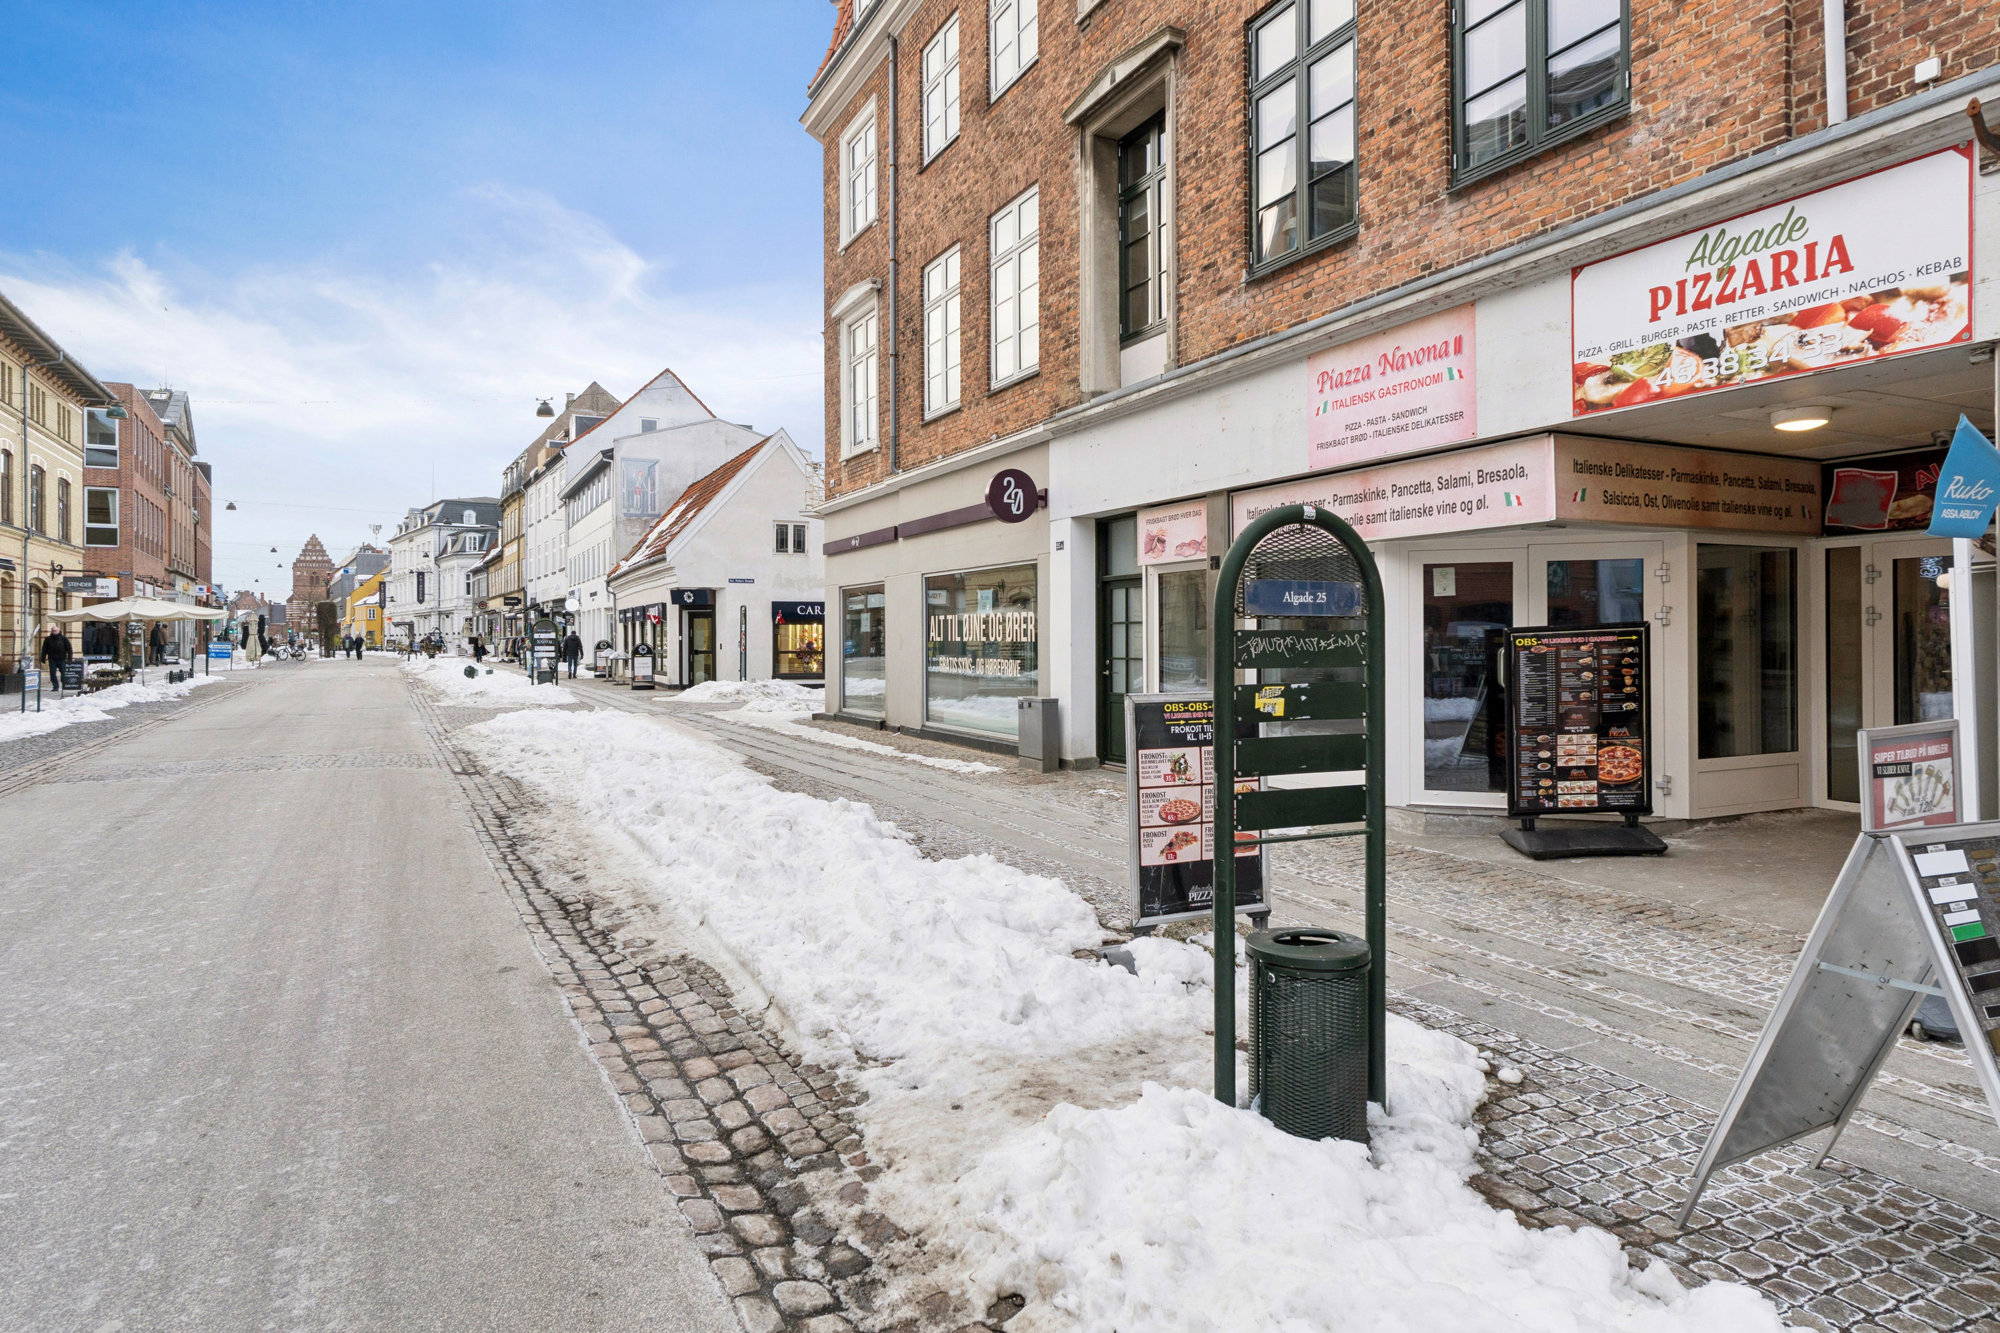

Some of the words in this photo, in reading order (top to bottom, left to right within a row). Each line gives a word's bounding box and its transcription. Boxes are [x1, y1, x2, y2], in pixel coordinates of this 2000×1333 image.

[1685, 206, 1809, 282] Algade
[1648, 234, 1854, 322] PIZZARIA
[1577, 346, 1603, 360] PIZZA
[1609, 338, 1634, 352] GRILL
[1641, 326, 1680, 345] BURGER
[1686, 318, 1717, 333] PASTE
[1725, 306, 1765, 324] RETTER
[1773, 287, 1839, 312] SANDWICH
[1848, 270, 1905, 293] NACHOS
[1916, 256, 1962, 277] KEBAB
[1316, 364, 1371, 394] Piazza
[1378, 340, 1450, 377] Navona
[1703, 350, 1740, 380] 38
[1331, 390, 1376, 411] ITALIENSK
[1378, 372, 1444, 398] GASTRONOMI
[1316, 436, 1349, 451] FRISKBAGT
[1350, 432, 1368, 444] BRØD
[1372, 421, 1410, 439] ITALIENSKE
[1411, 411, 1464, 430] DELIKATESSER
[1345, 421, 1362, 432] PIZZA
[1366, 415, 1387, 427] PASTA
[1391, 405, 1428, 422] SANDWICH
[1332, 486, 1389, 507] Parmaskinke,
[1391, 479, 1434, 498] Pancetta,
[1437, 471, 1474, 491] Salami,
[1477, 463, 1529, 485] Bresaola,
[1573, 458, 1613, 477] Italienske
[1615, 462, 1665, 480] Delikatesser
[1671, 468, 1721, 487] Parmaskinke,
[1723, 472, 1757, 490] Pancetta,
[1758, 476, 1784, 493] Salami,
[1943, 475, 1995, 501] Ruko
[1365, 508, 1387, 525] samt
[1389, 503, 1434, 522] italienske
[1436, 500, 1457, 516] vine
[1460, 499, 1473, 516] og
[1476, 494, 1489, 511] øl.
[1602, 489, 1642, 509] Salsiccia,
[1643, 493, 1660, 511] Ost,
[1661, 494, 1700, 512] Olivenolie
[1701, 499, 1721, 513] samt
[1721, 499, 1756, 515] italienske
[1757, 502, 1773, 516] vine
[1773, 506, 1783, 520] og
[1941, 509, 1960, 519] ASSA
[1961, 509, 1982, 519] ABLOY
[1282, 591, 1314, 606] Algade
[1316, 592, 1327, 603] 25
[930, 614, 945, 642] ALT
[946, 614, 961, 642] TIL
[962, 612, 987, 642] ØJNE
[988, 612, 1003, 642] OG
[1005, 611, 1035, 642] ØRER
[976, 658, 985, 675] OG
[1164, 702, 1213, 712] OBS-OBS-
[1171, 725, 1202, 734] FROKOST
[1141, 752, 1165, 760] FROKOST
[1873, 751, 1895, 764] SUPER
[1896, 748, 1917, 760] TILBUD
[1141, 791, 1166, 799] FROKOST
[1142, 831, 1167, 839] FROKOST
